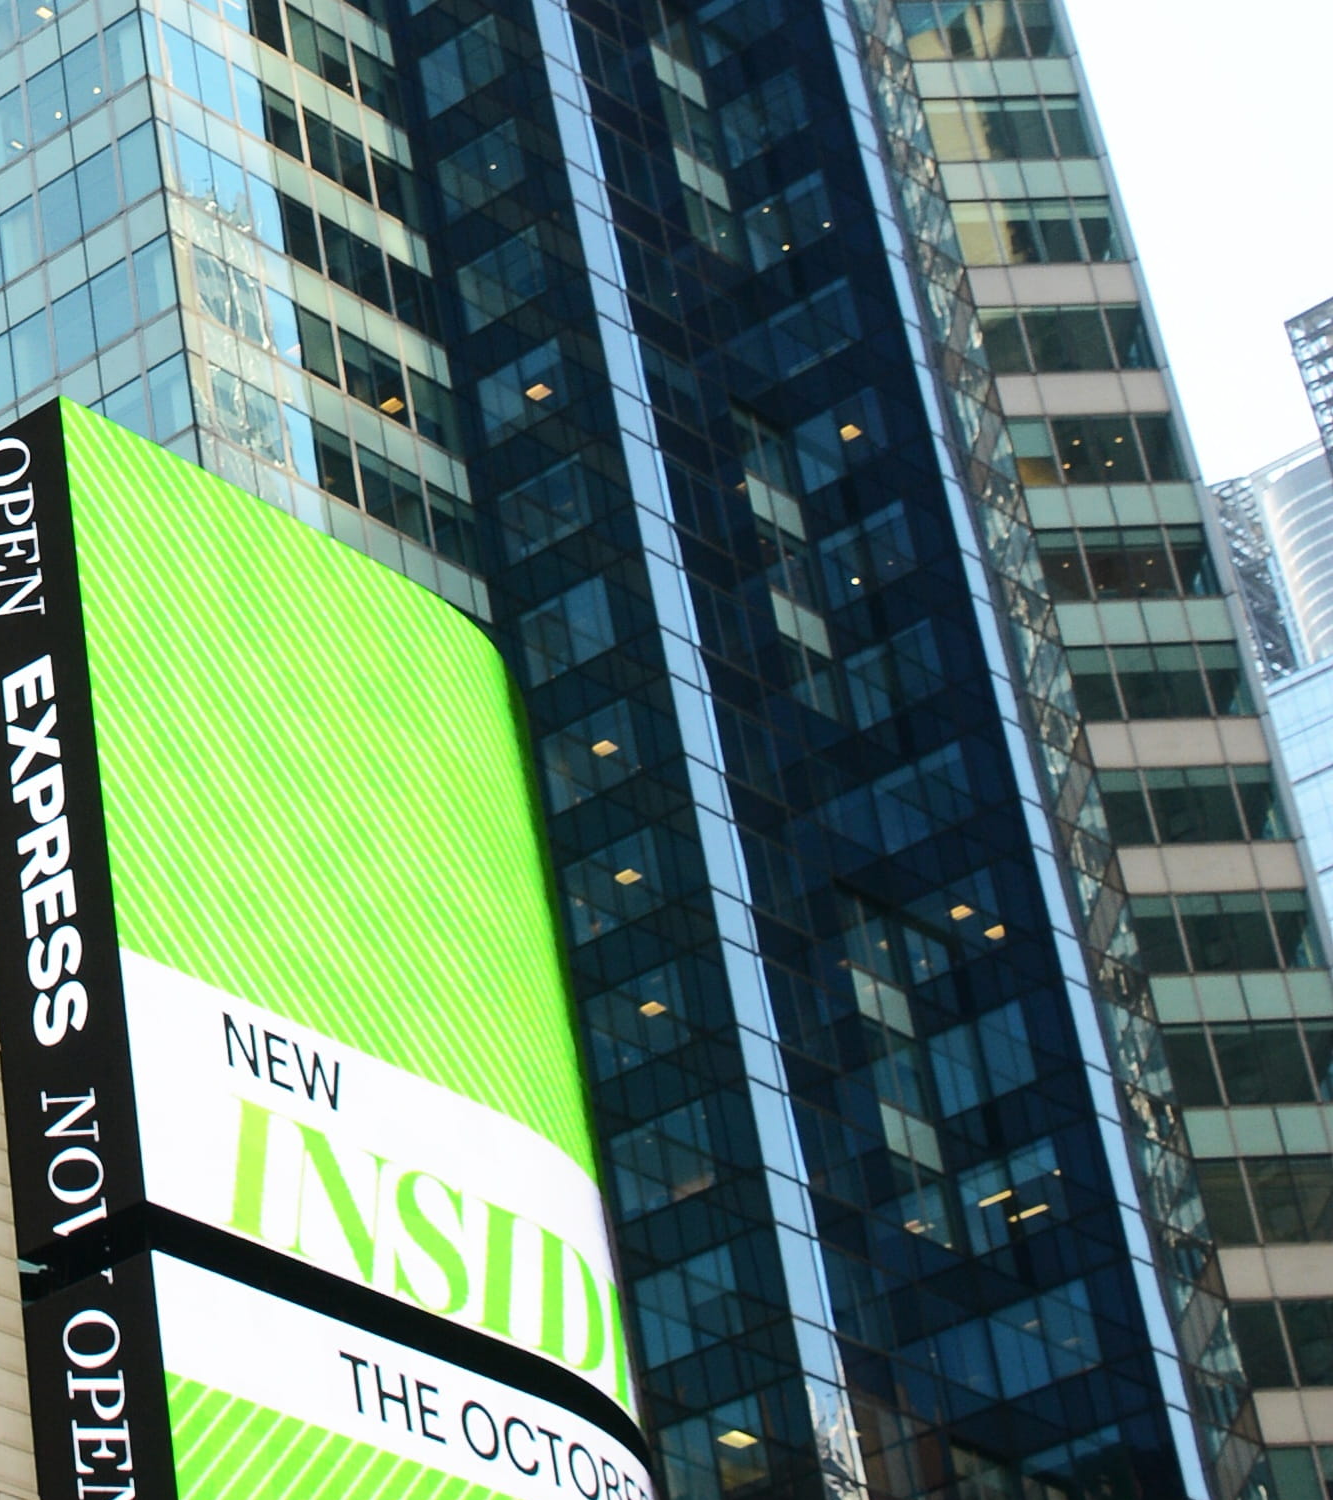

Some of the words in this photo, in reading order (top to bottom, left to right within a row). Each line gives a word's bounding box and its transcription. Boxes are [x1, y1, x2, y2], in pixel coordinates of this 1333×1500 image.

[0, 653, 88, 1048] EXPRESS
[223, 1011, 340, 1112] NEW
[339, 1350, 447, 1445] THE
